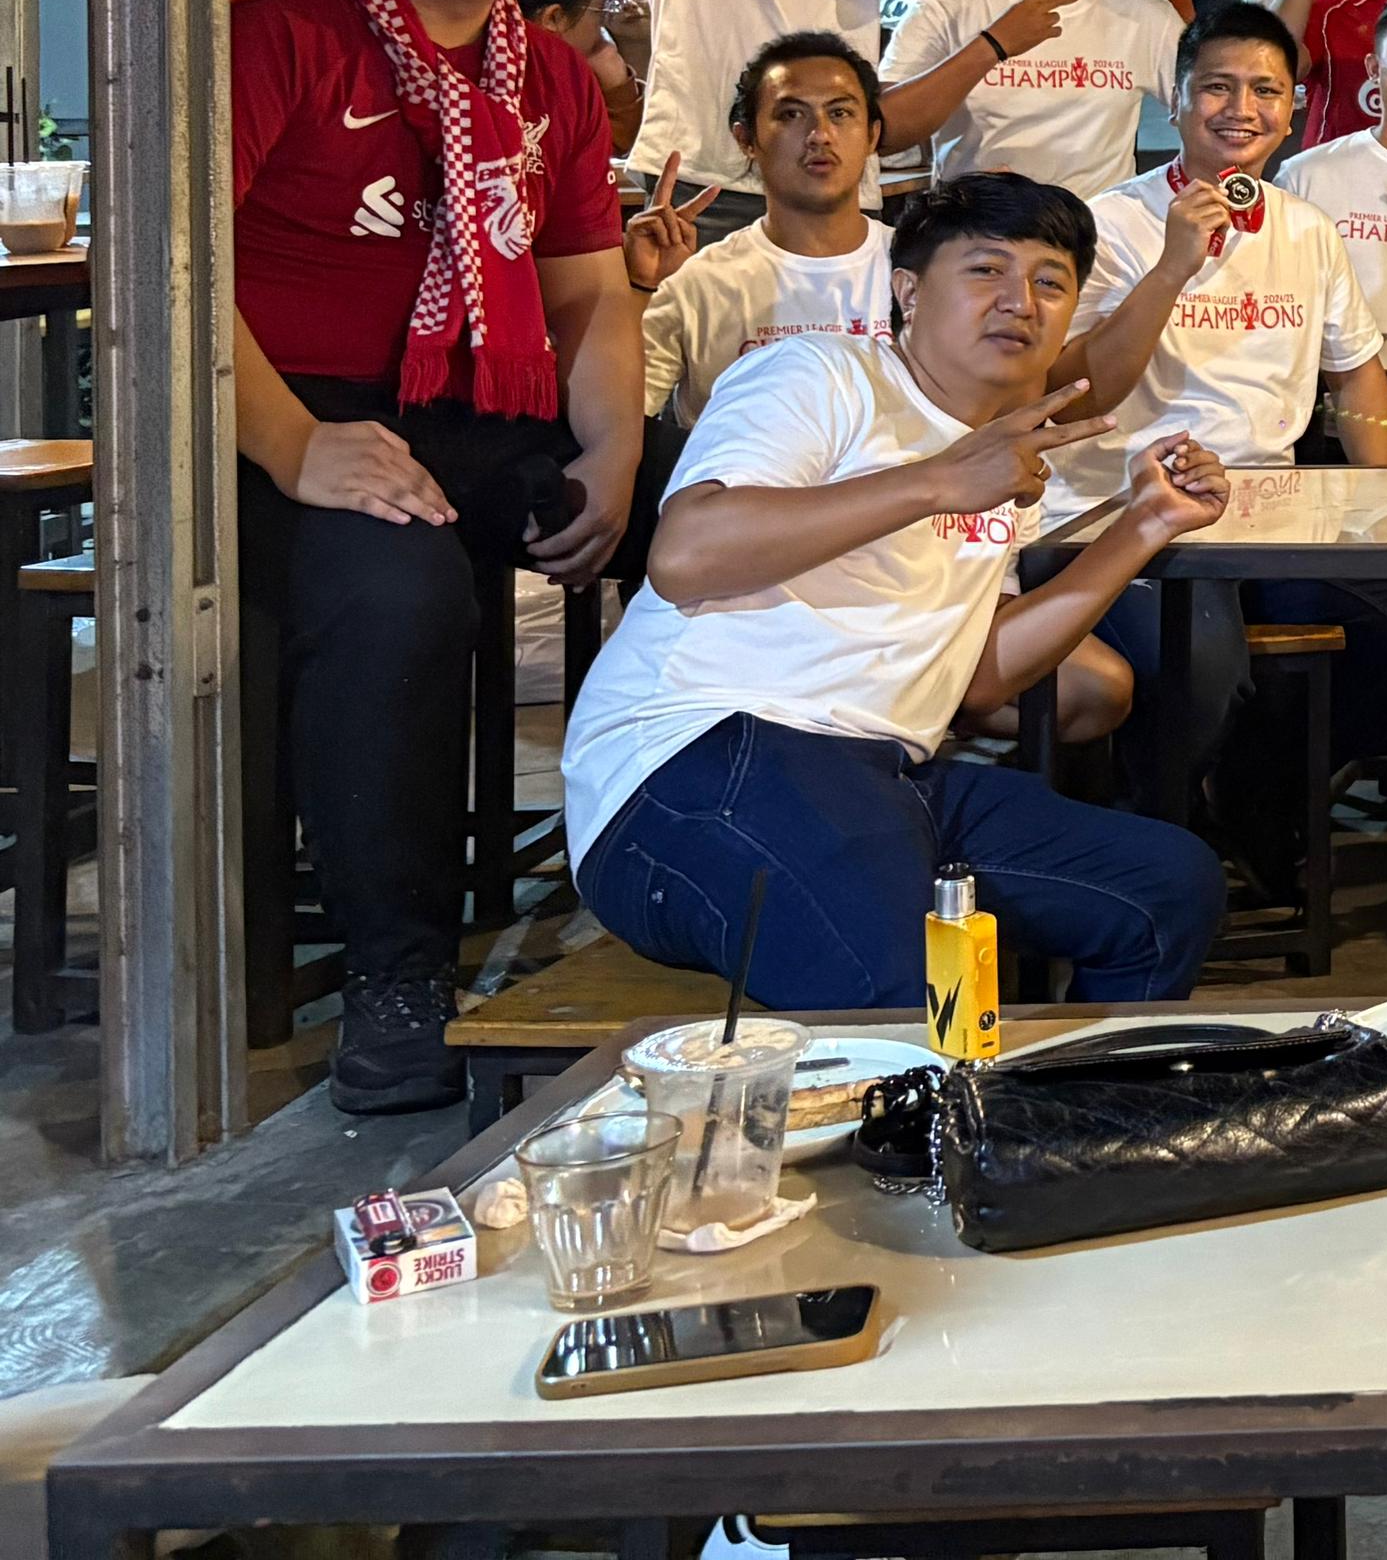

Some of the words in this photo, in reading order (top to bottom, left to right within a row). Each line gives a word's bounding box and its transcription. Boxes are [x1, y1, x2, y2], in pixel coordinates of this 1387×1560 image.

[1035, 59, 1068, 69] LEAGUE
[757, 325, 803, 337] PREMIER
[414, 1248, 465, 1272] STRIKE
[415, 1263, 462, 1287] LUCKY
